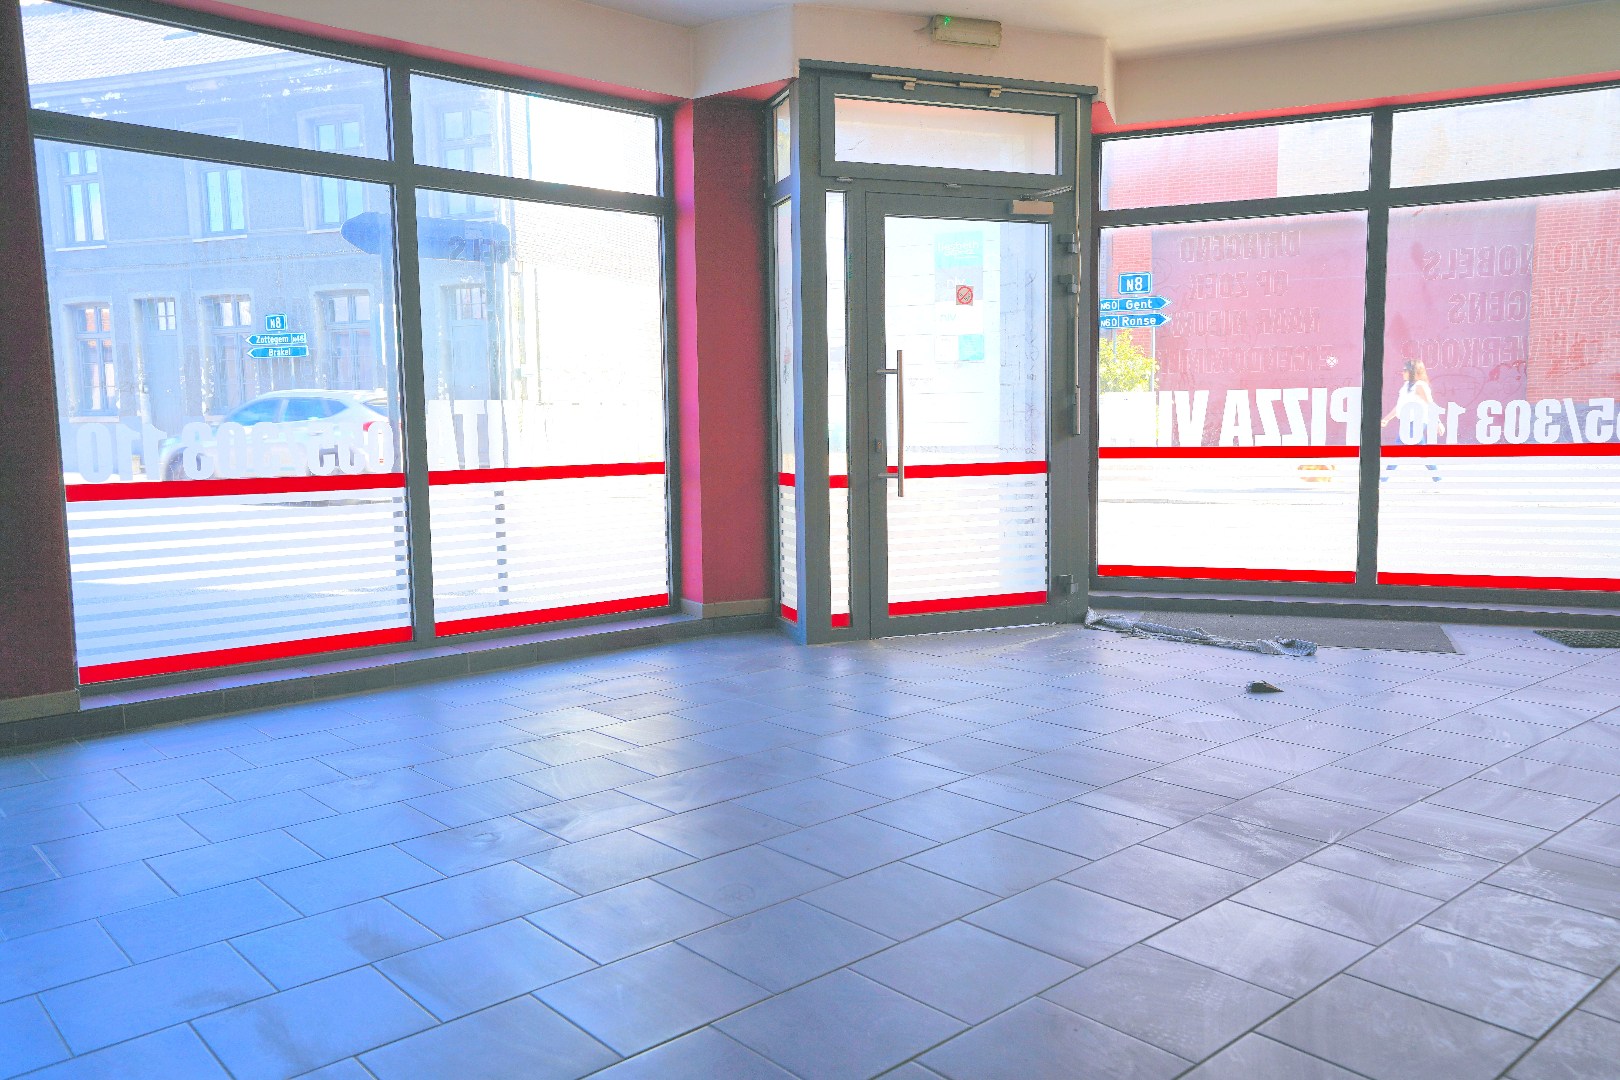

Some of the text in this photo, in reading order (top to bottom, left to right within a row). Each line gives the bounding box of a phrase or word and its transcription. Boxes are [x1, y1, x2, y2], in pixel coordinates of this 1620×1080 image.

[1126, 276, 1143, 292] N8
[1100, 298, 1153, 310] N60 Gent
[269, 316, 282, 329] N8
[1100, 316, 1157, 327] N60 Ronse
[255, 335, 289, 345] Zottegem
[268, 347, 291, 357] Brakel
